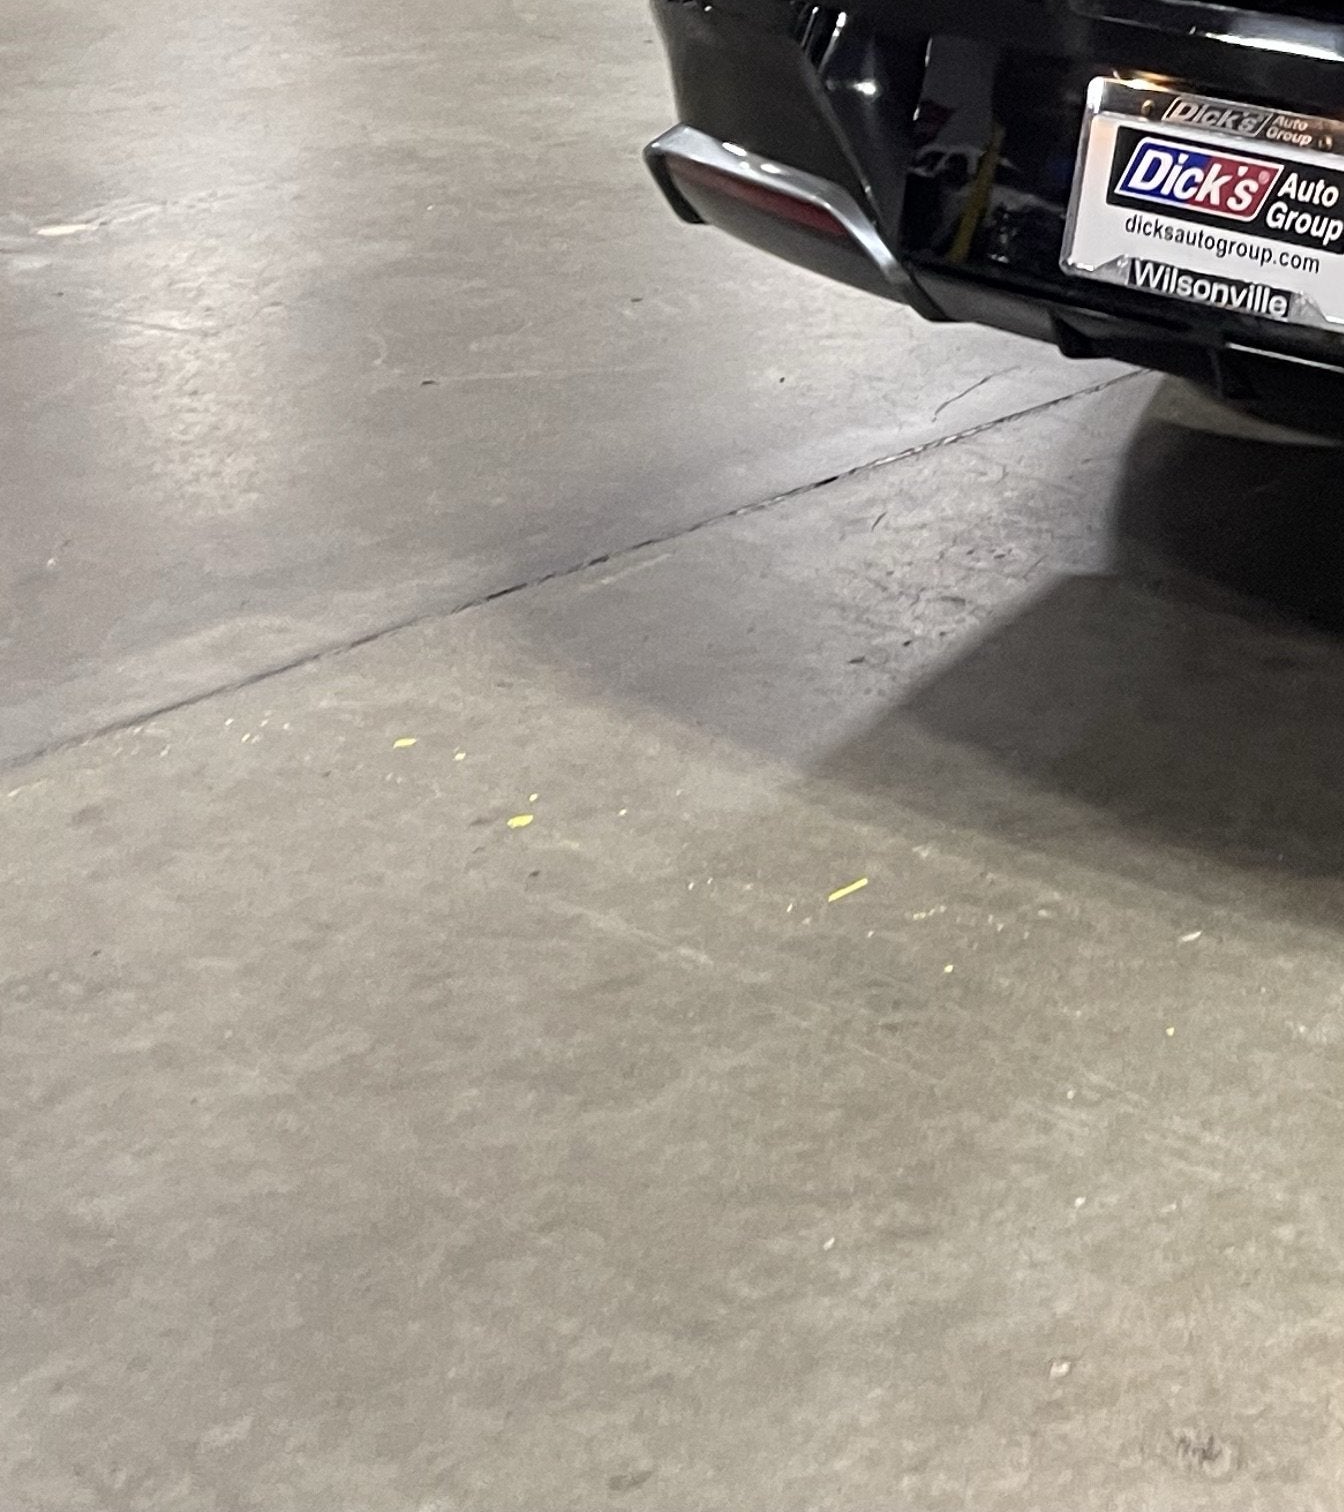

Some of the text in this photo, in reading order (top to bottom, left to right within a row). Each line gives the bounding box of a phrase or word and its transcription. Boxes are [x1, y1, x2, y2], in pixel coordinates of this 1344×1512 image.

[1166, 101, 1308, 133] Dick's Auto
[1266, 126, 1312, 146] Group
[1127, 148, 1340, 211] Dick's Auto
[1125, 214, 1320, 274] dicksautogroup.com
[1265, 200, 1344, 246] Group
[1132, 260, 1289, 319] Wilsonville
